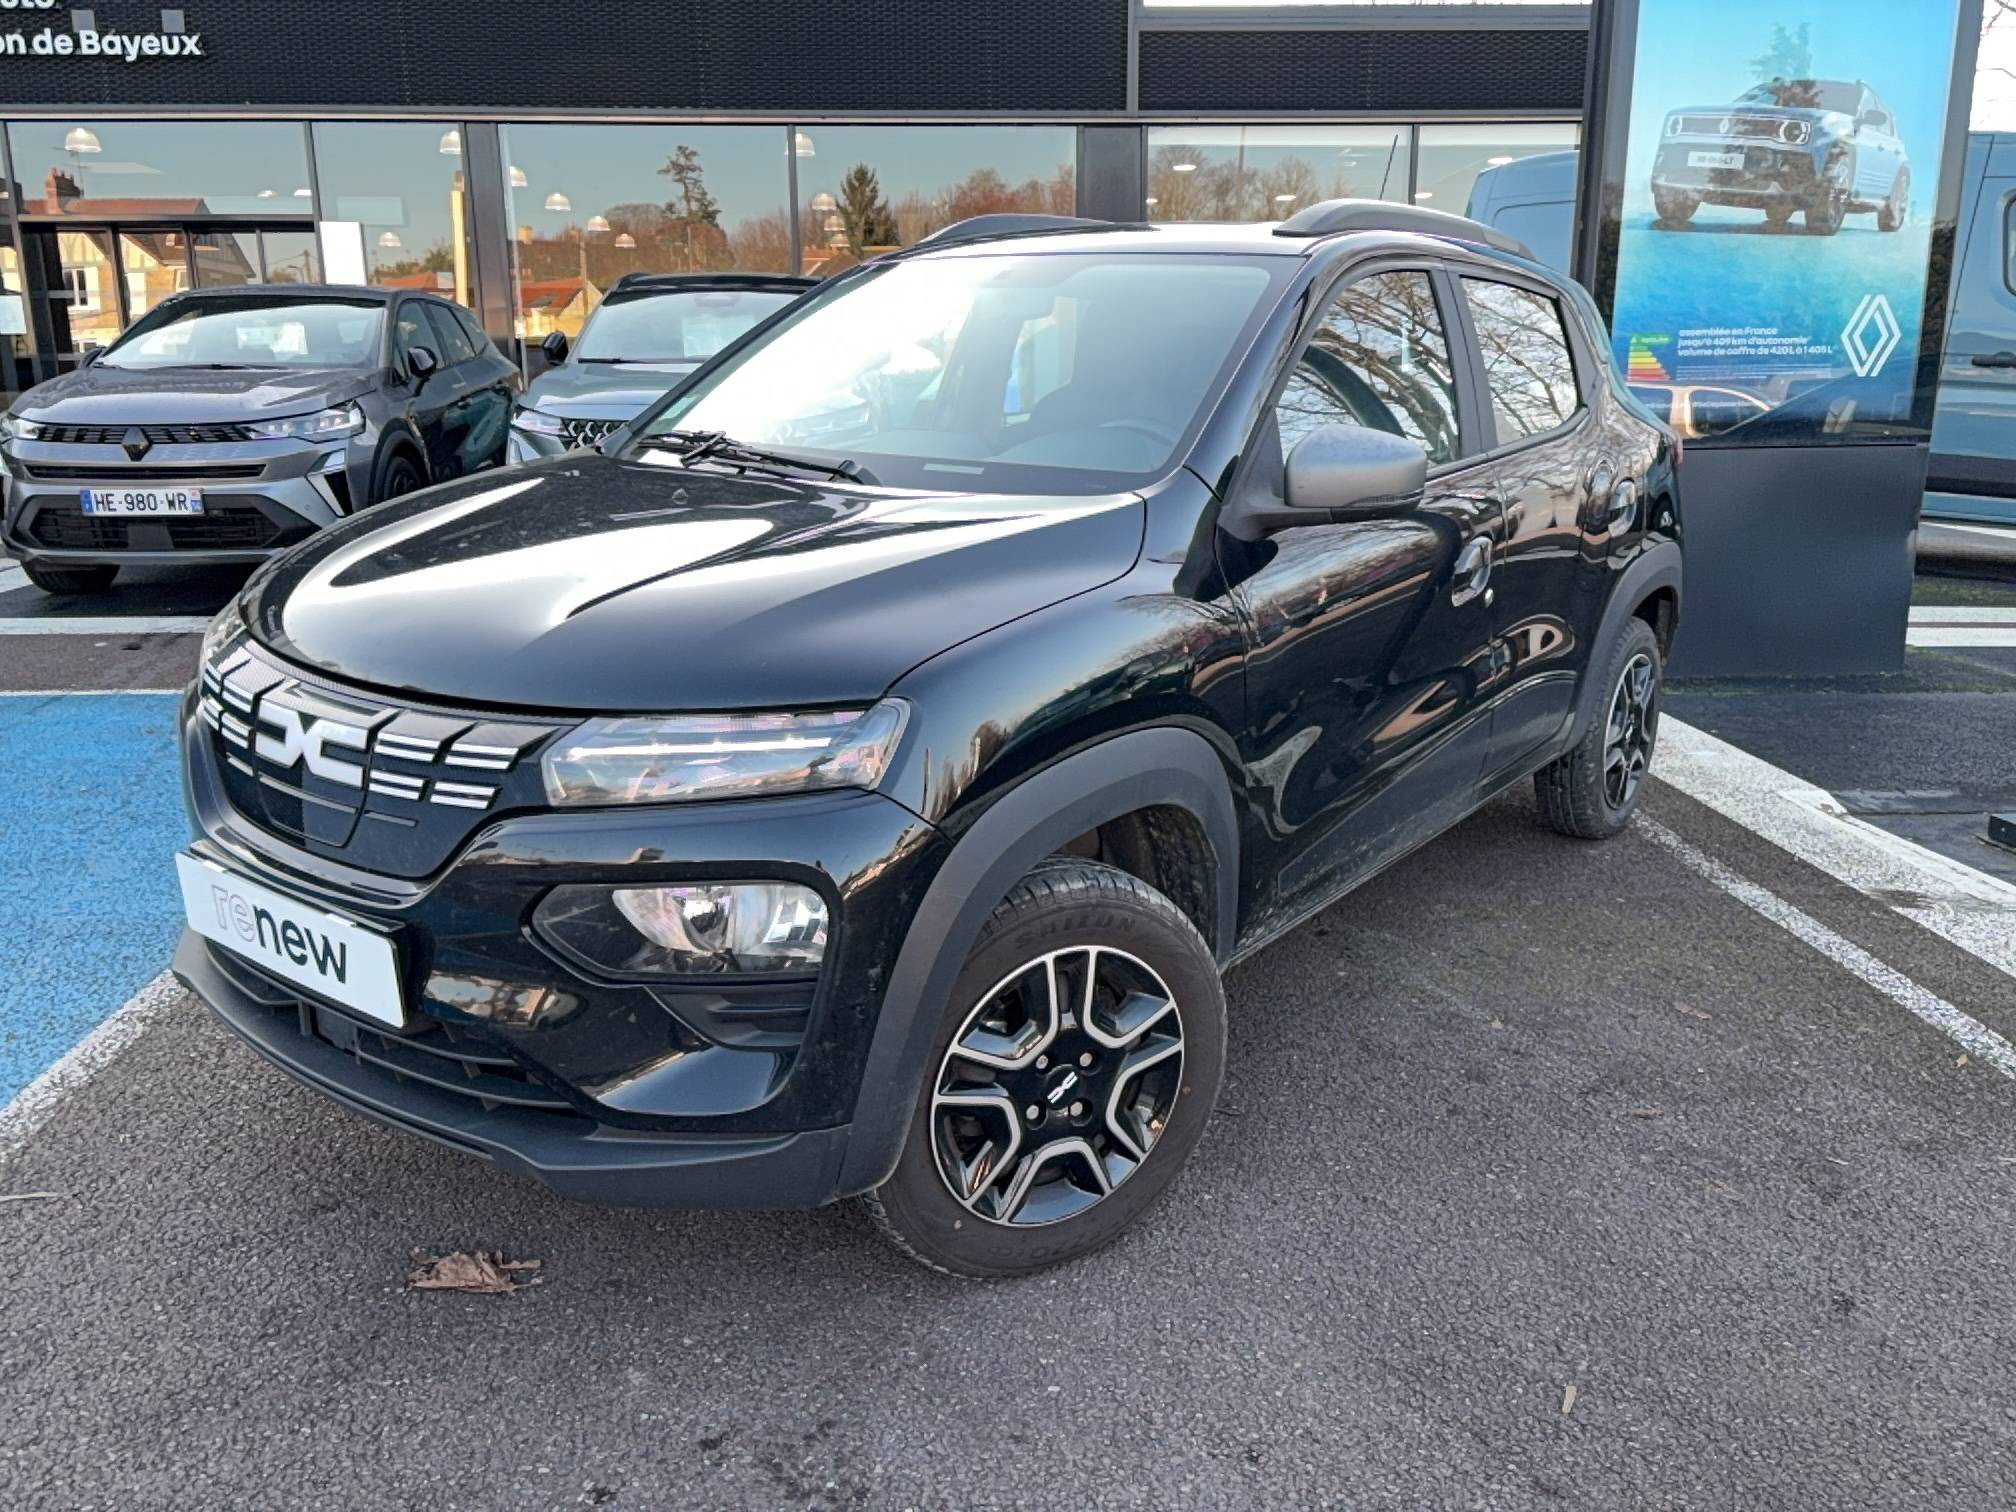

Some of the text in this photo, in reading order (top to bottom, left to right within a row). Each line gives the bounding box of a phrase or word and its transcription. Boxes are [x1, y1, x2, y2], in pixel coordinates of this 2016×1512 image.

[0, 27, 201, 62] n de Bayeux
[210, 883, 347, 985] renew
